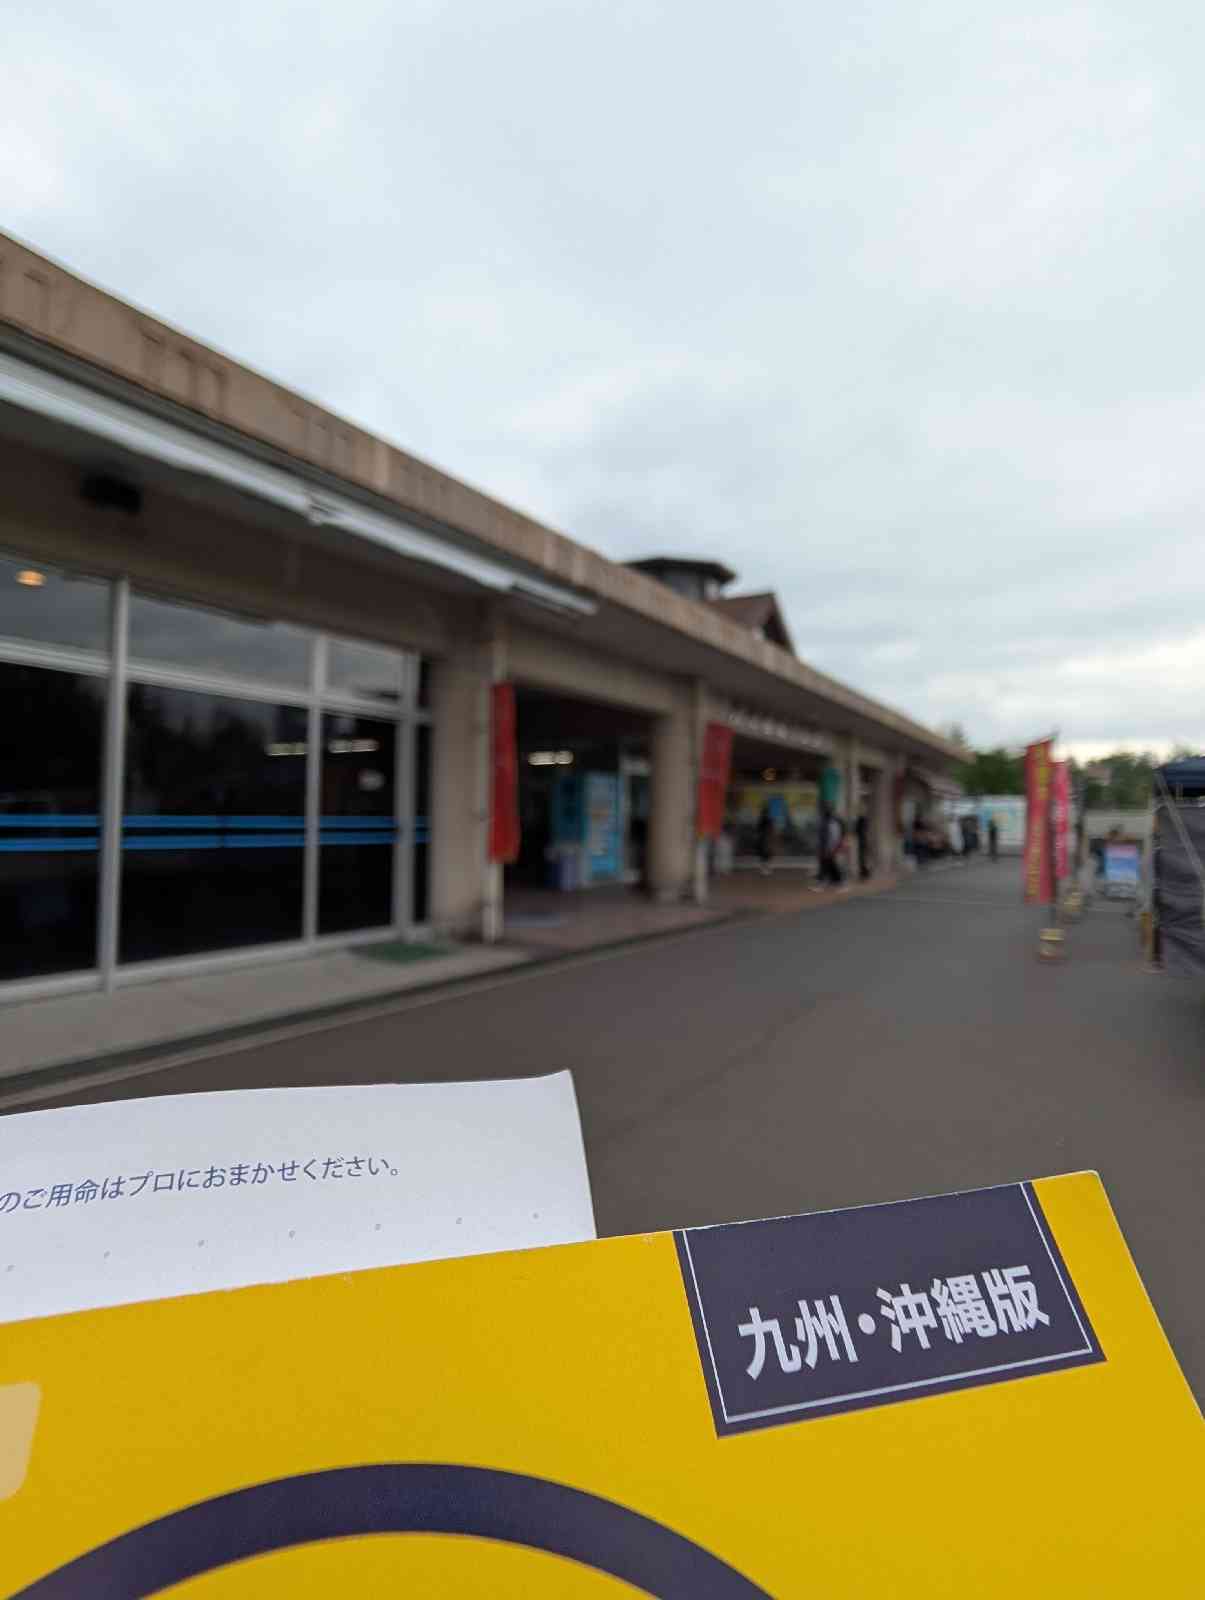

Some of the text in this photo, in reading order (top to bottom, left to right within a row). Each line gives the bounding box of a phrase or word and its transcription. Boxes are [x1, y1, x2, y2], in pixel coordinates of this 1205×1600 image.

[0, 1155, 399, 1213] のご用命はプロにおまかせください。
[738, 1264, 1050, 1380] 九州・沖縄版
